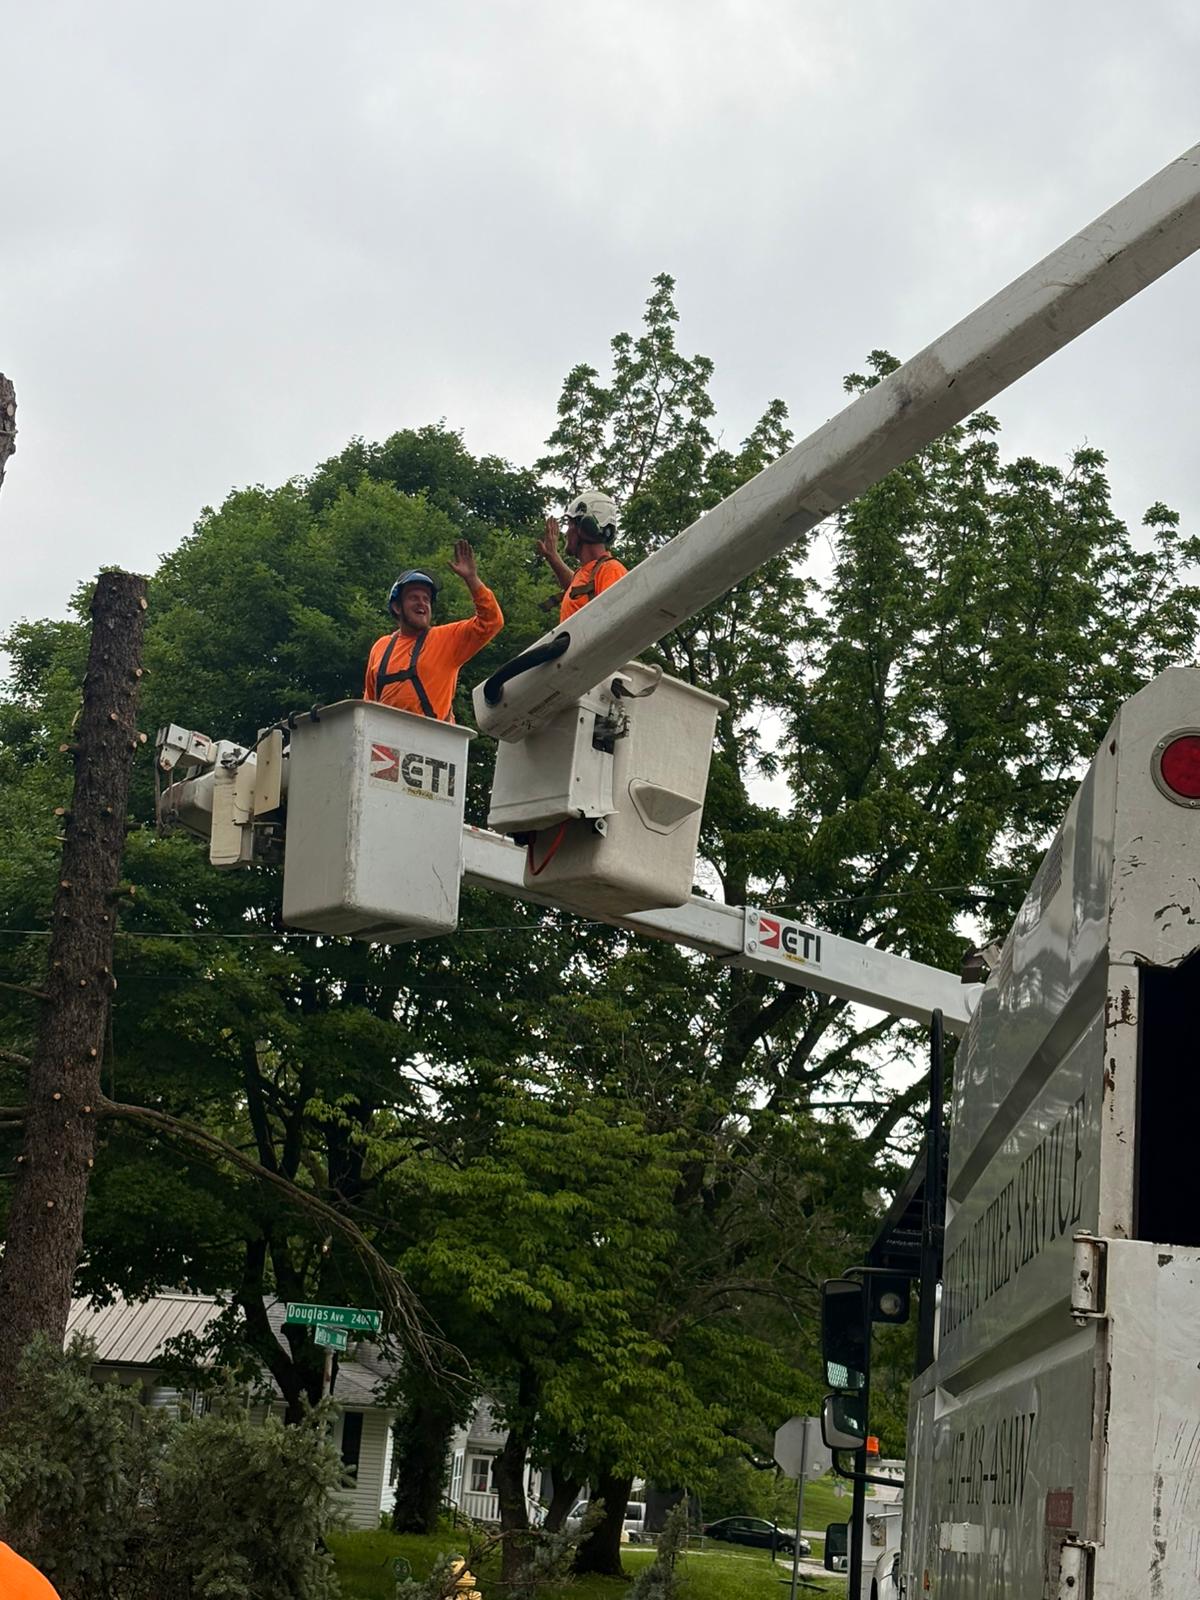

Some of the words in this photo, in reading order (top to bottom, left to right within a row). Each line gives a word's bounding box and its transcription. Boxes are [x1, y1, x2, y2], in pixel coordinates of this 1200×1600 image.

[402, 753, 455, 797] ETI
[781, 926, 821, 963] ETI
[985, 1178, 1014, 1300] TREE
[1014, 1092, 1085, 1273] SERVICE
[288, 1304, 328, 1323] Douglas
[330, 1311, 344, 1322] Ave
